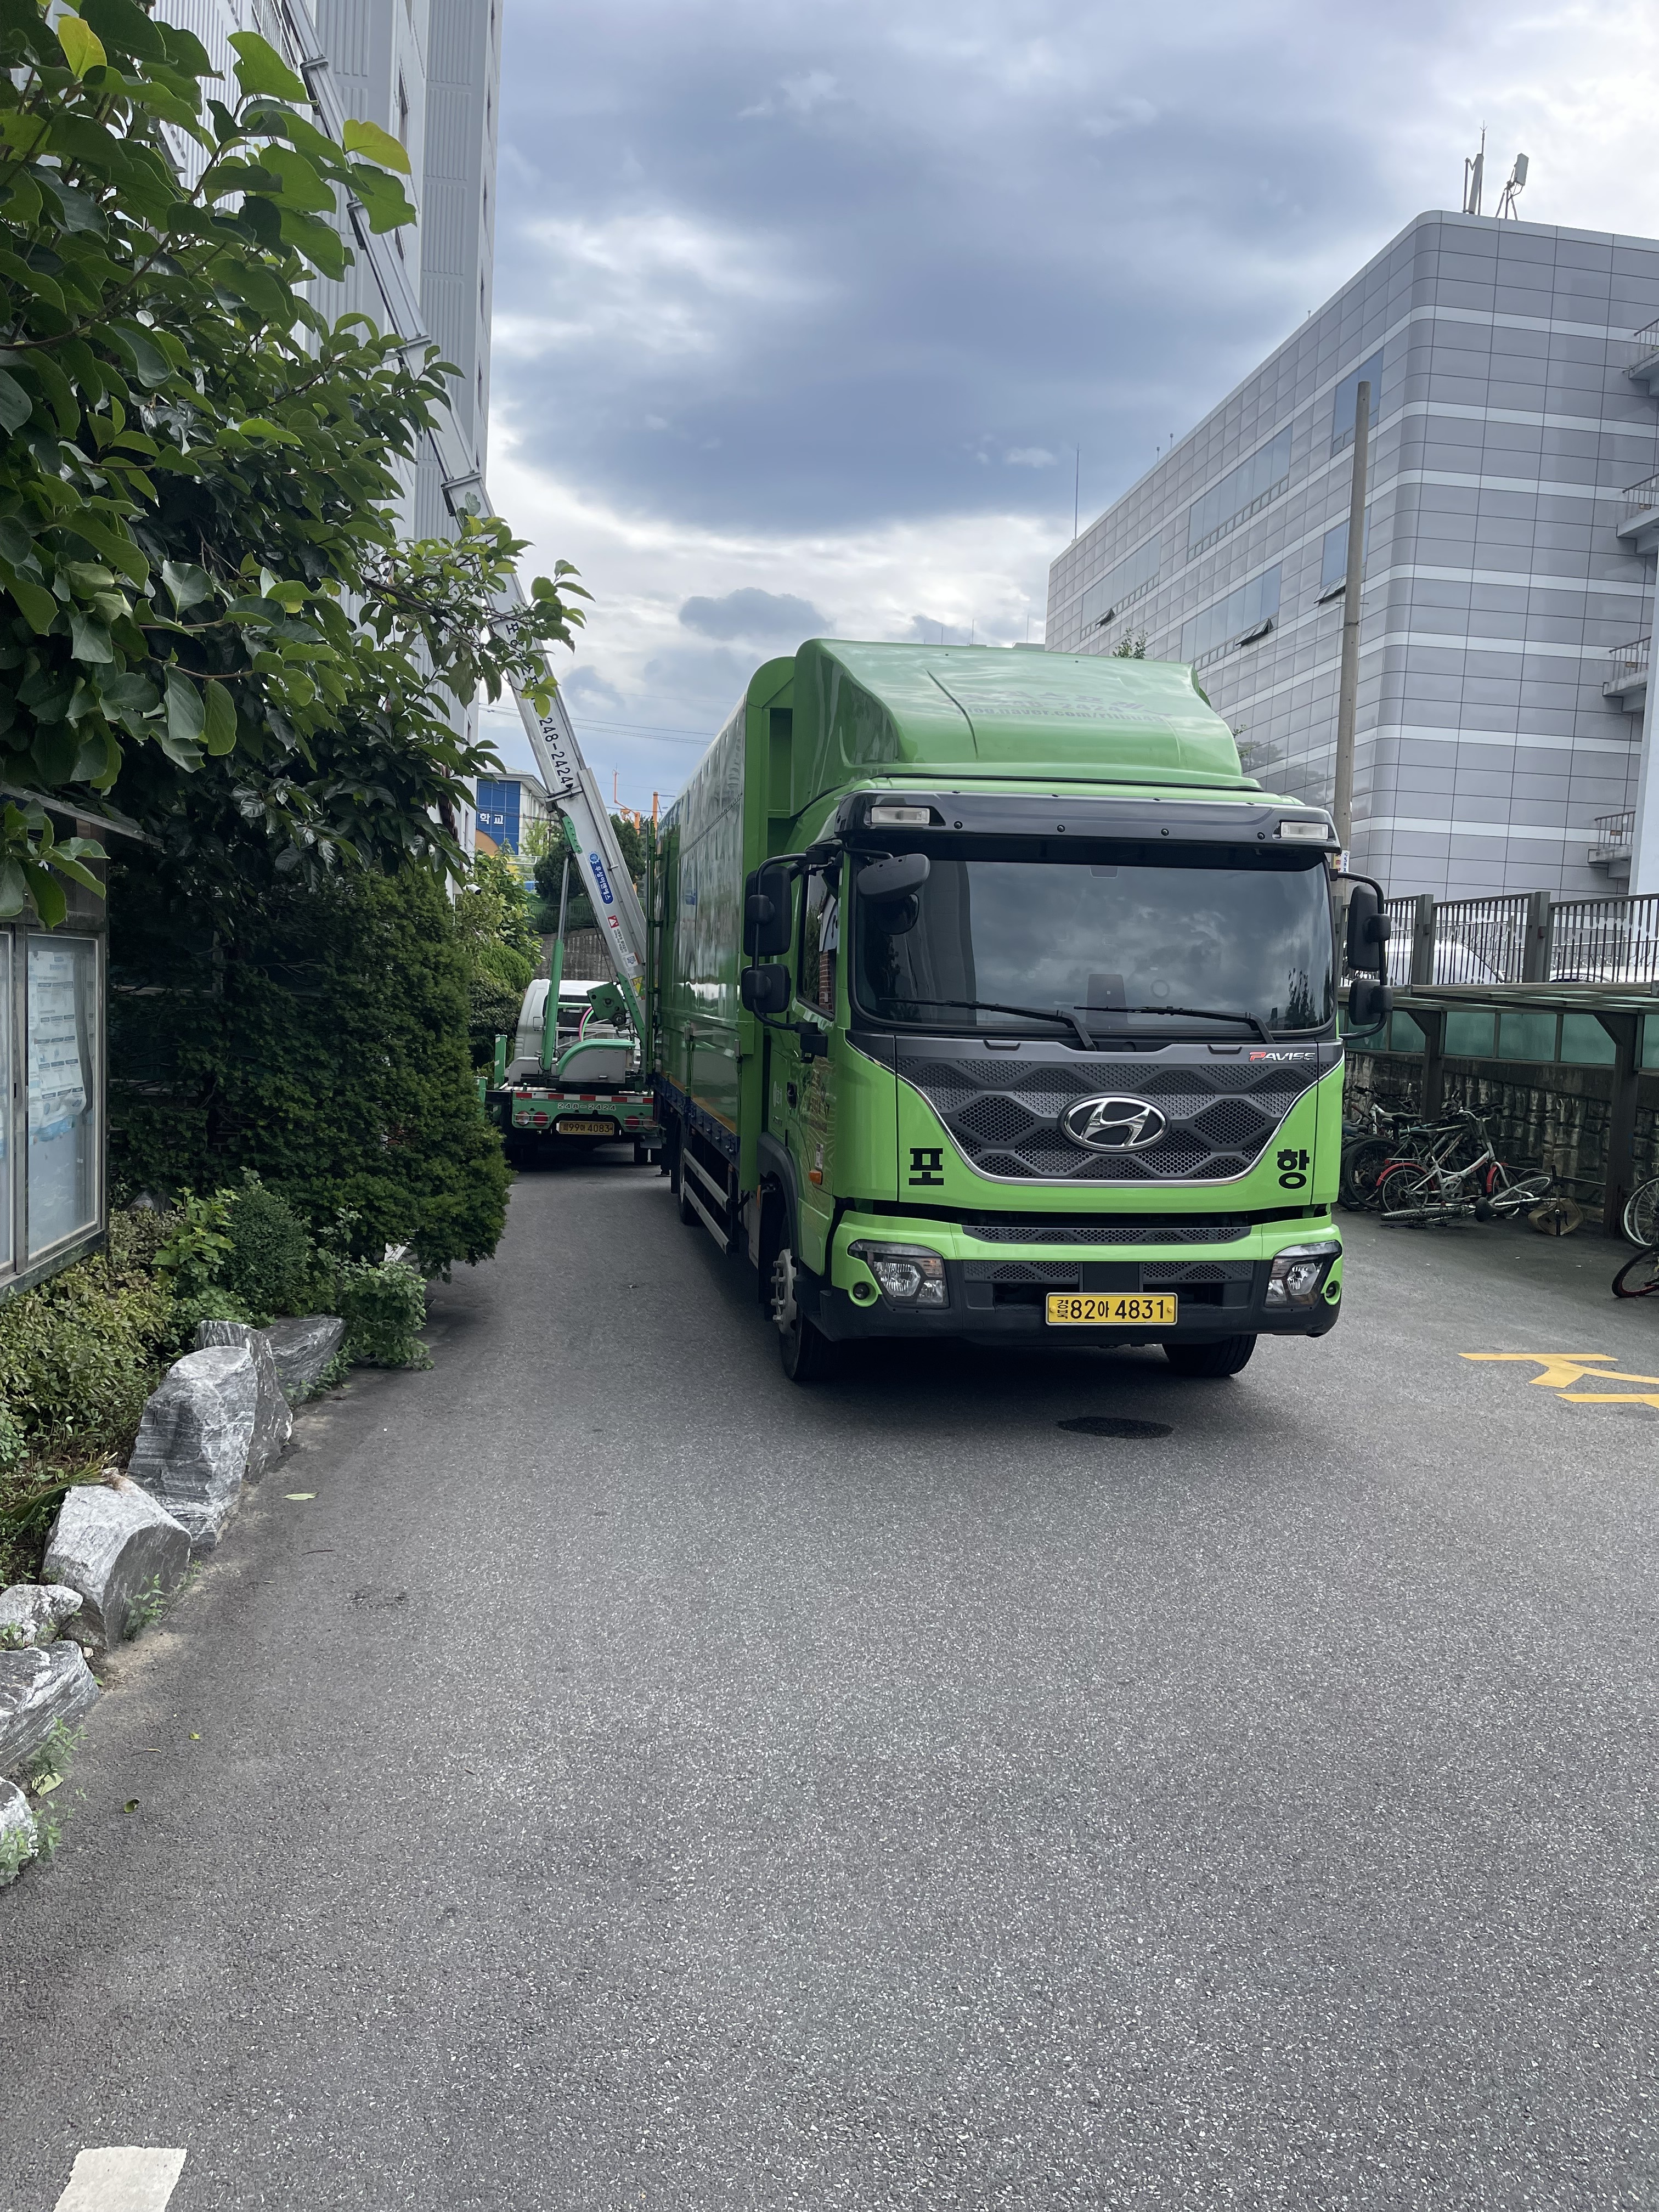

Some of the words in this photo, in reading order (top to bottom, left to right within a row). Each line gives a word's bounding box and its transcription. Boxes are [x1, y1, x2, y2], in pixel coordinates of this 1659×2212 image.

[539, 717, 574, 783] 248-2424
[480, 813, 504, 825] 학교
[1249, 1051, 1316, 1062] PAVISE
[557, 1102, 616, 1110] 248-2424
[588, 1124, 610, 1132] 4083
[1057, 1299, 1069, 1319] 경북
[1070, 1299, 1110, 1319] 82아
[1115, 1299, 1164, 1319] 4831
